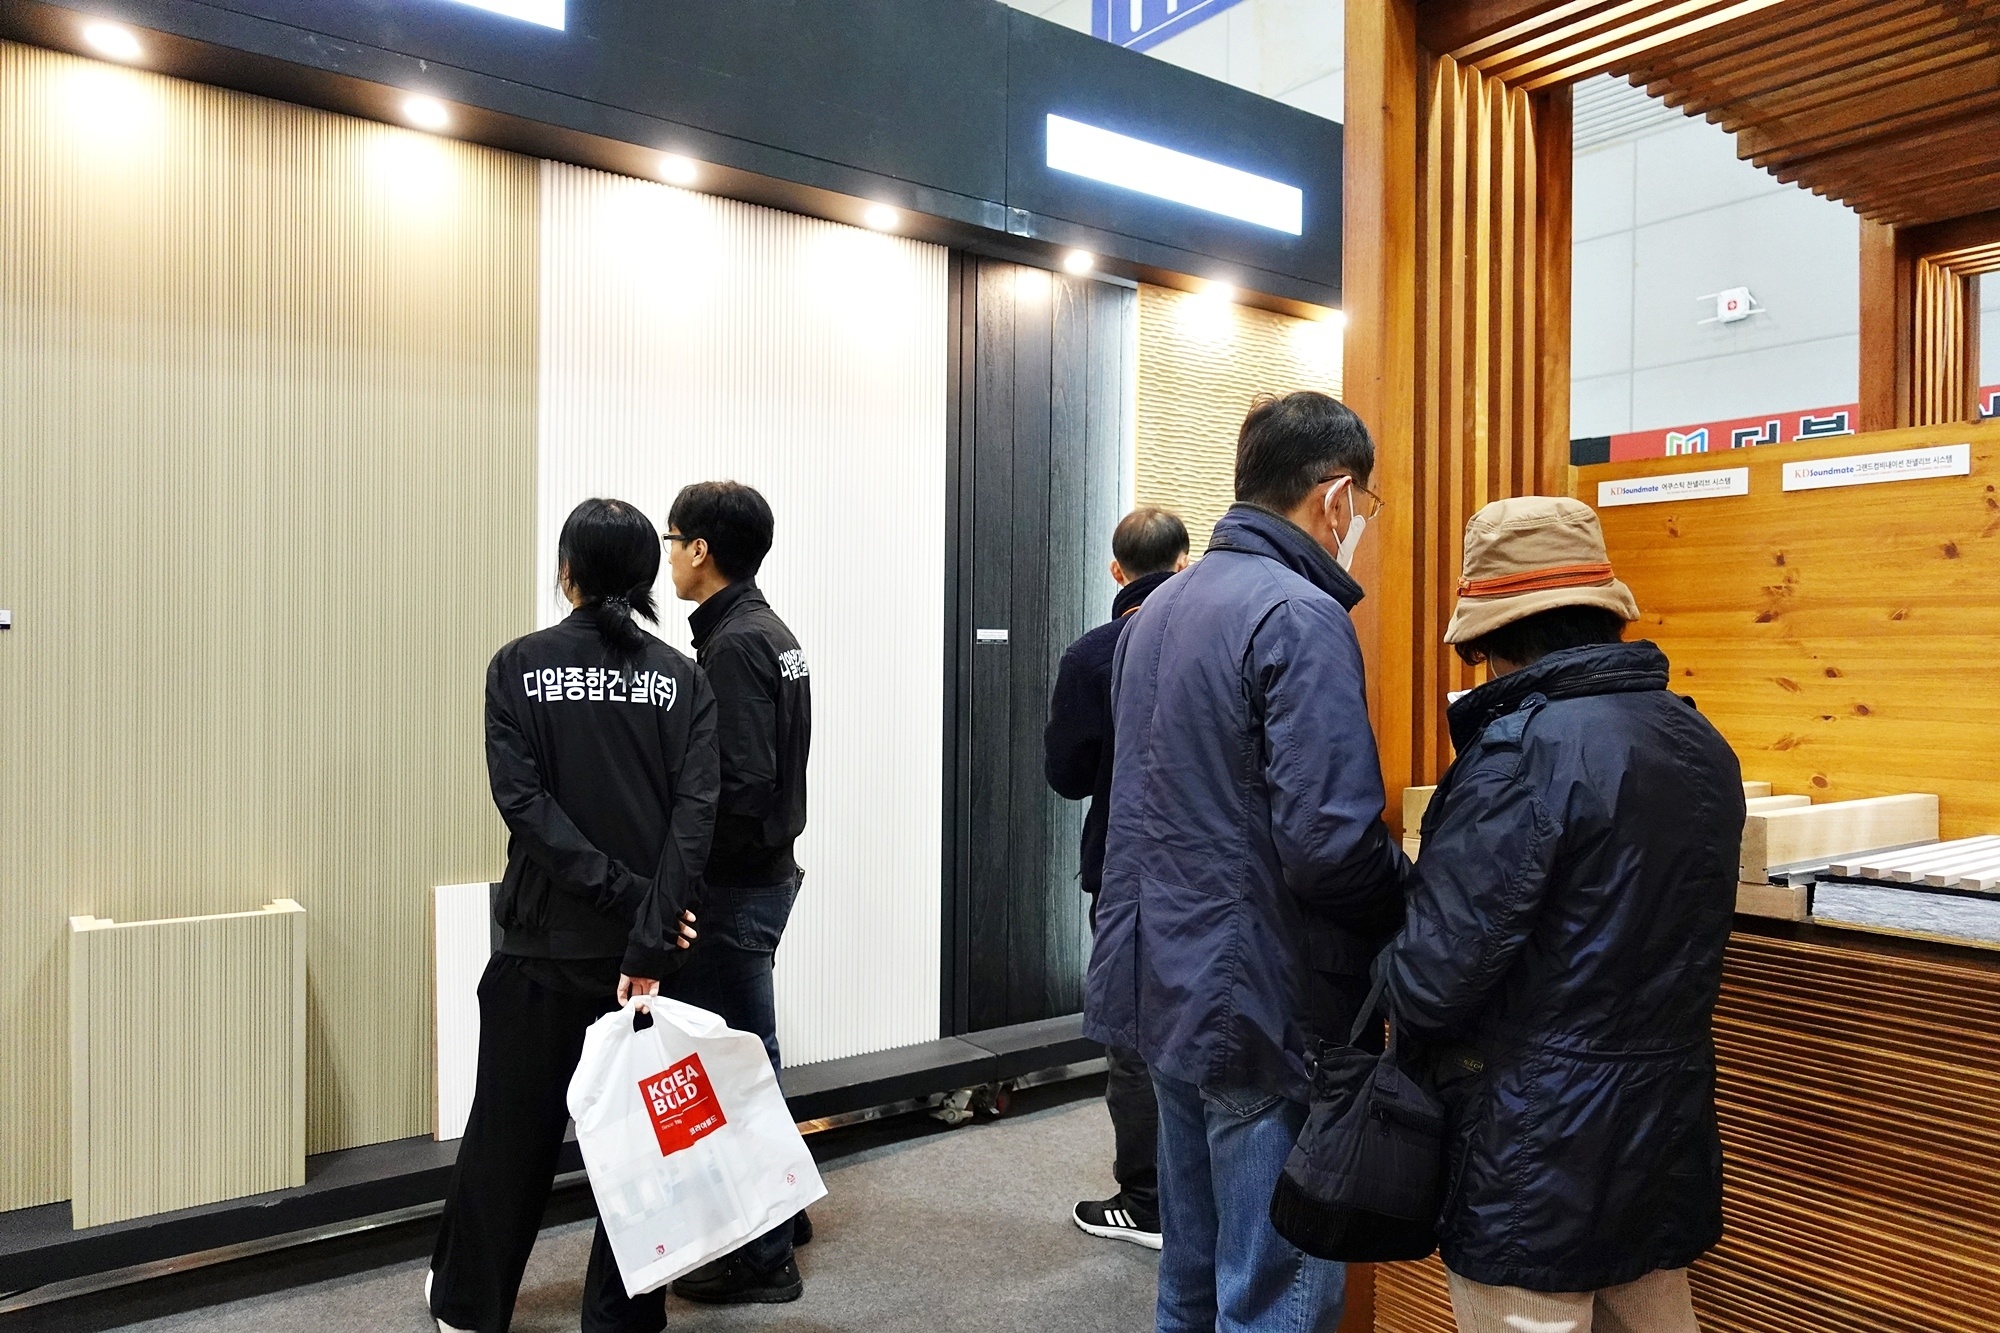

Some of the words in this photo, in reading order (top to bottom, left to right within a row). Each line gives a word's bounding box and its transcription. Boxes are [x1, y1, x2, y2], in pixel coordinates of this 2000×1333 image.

[1933, 455, 1953, 464] 시스템
[1661, 481, 1685, 490] 어쿠스틱
[1713, 477, 1731, 486] 시스템
[523, 667, 677, 712] 디알종합건설(주)
[653, 1083, 698, 1116] BULD
